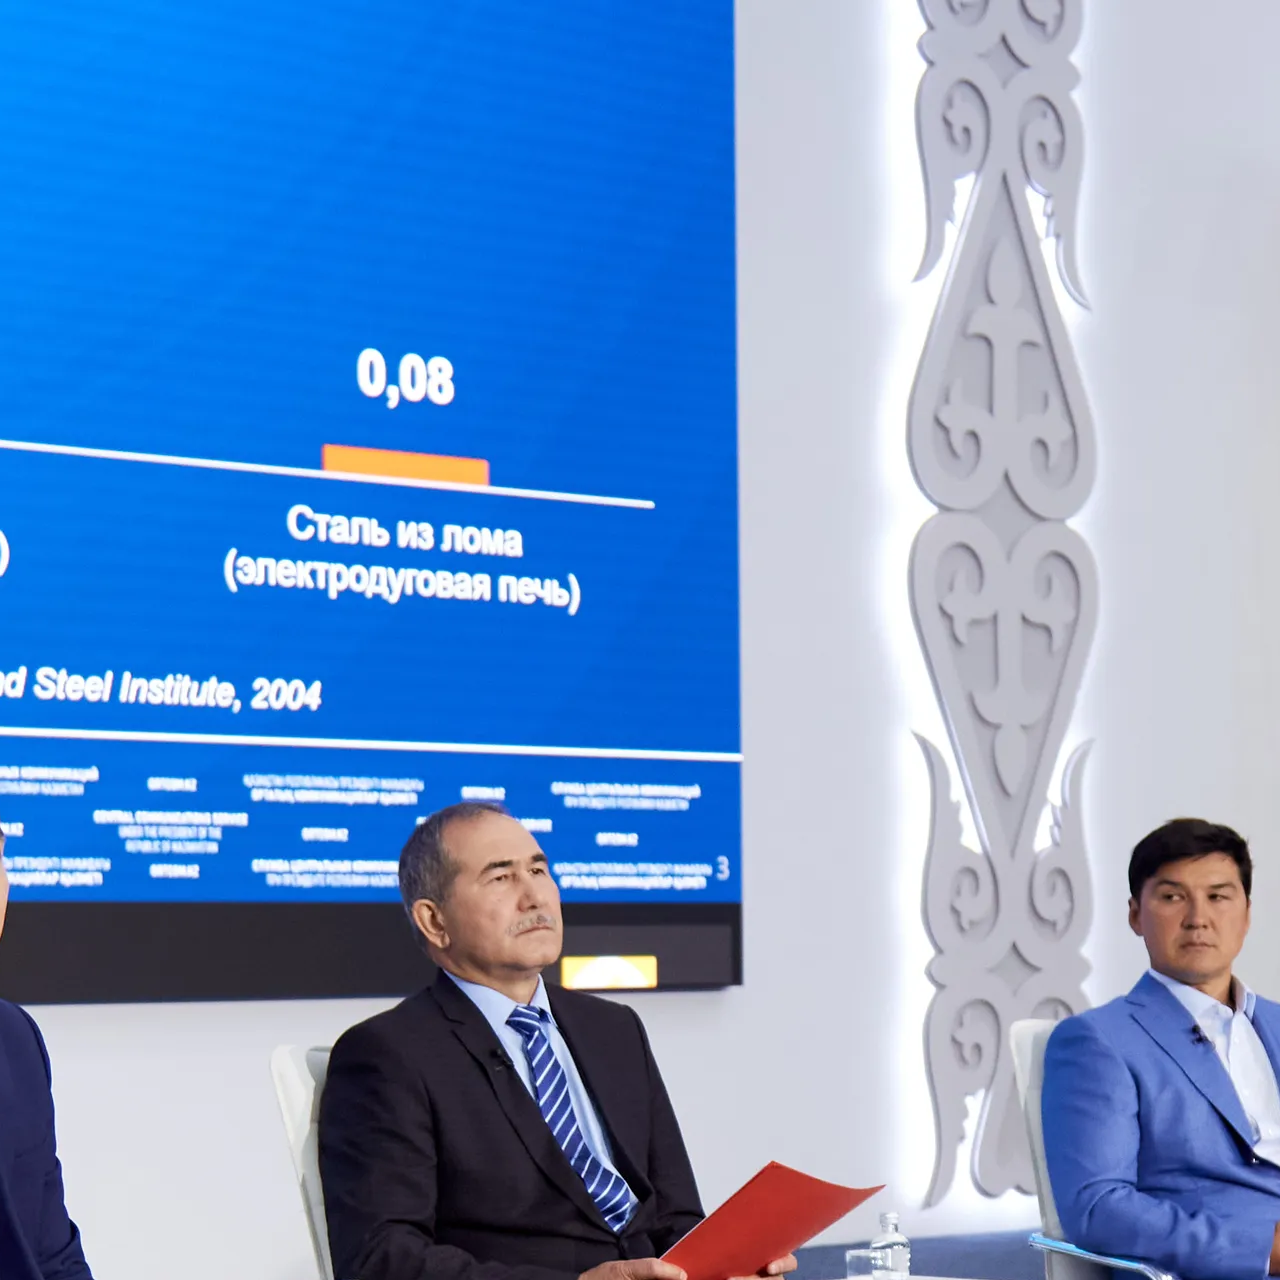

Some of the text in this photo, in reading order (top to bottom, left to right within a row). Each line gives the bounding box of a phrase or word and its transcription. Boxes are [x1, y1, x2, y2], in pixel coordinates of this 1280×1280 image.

[356, 347, 455, 409] 0,08
[286, 504, 524, 558] Сталь из лома
[223, 547, 581, 616] (электродуговая печь)
[33, 666, 112, 704] Steel
[120, 670, 243, 713] Institute,
[251, 676, 322, 712] 2004
[715, 855, 731, 881] 3
